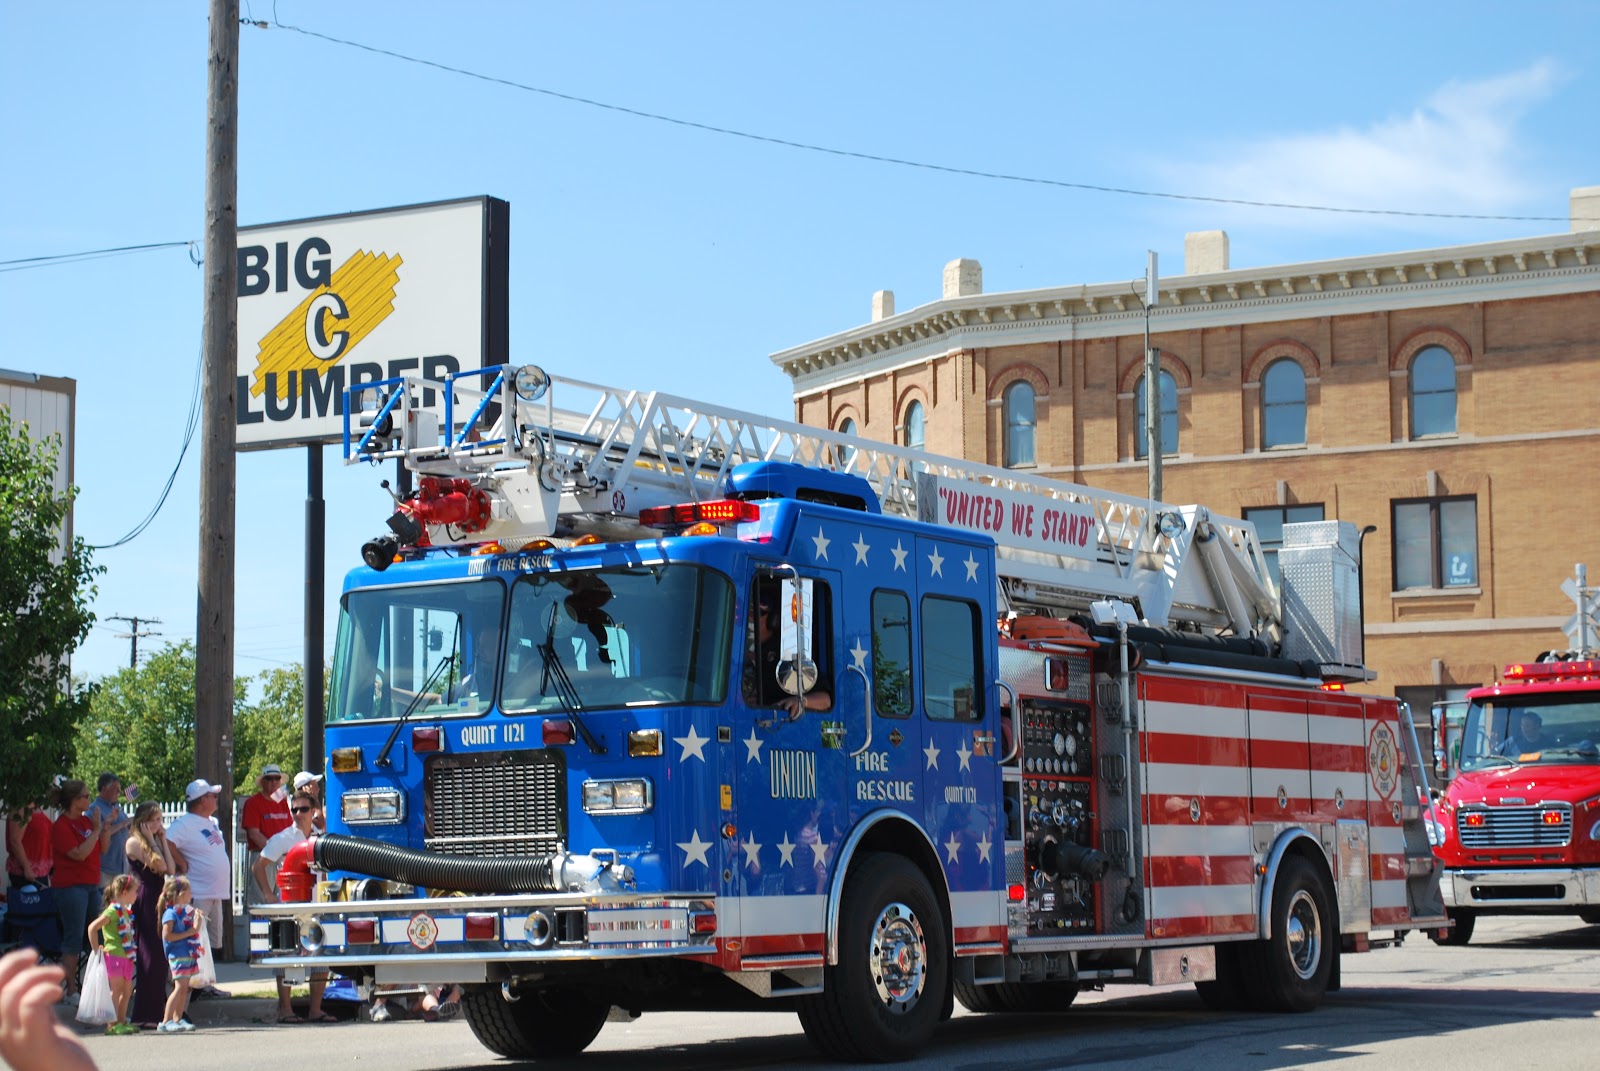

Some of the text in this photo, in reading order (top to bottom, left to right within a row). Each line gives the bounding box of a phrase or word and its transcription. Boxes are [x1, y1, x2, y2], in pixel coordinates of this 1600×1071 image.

[237, 237, 331, 297] BIG
[305, 292, 350, 361] C
[1012, 502, 1034, 537] WE
[497, 557, 516, 571] FIRE
[519, 555, 552, 570] RESCUE
[461, 723, 525, 747] QUINT 1121
[855, 752, 889, 771] FIRE
[770, 750, 816, 799] UNION
[857, 780, 914, 801] RESCUE
[945, 786, 963, 804] QUINT
